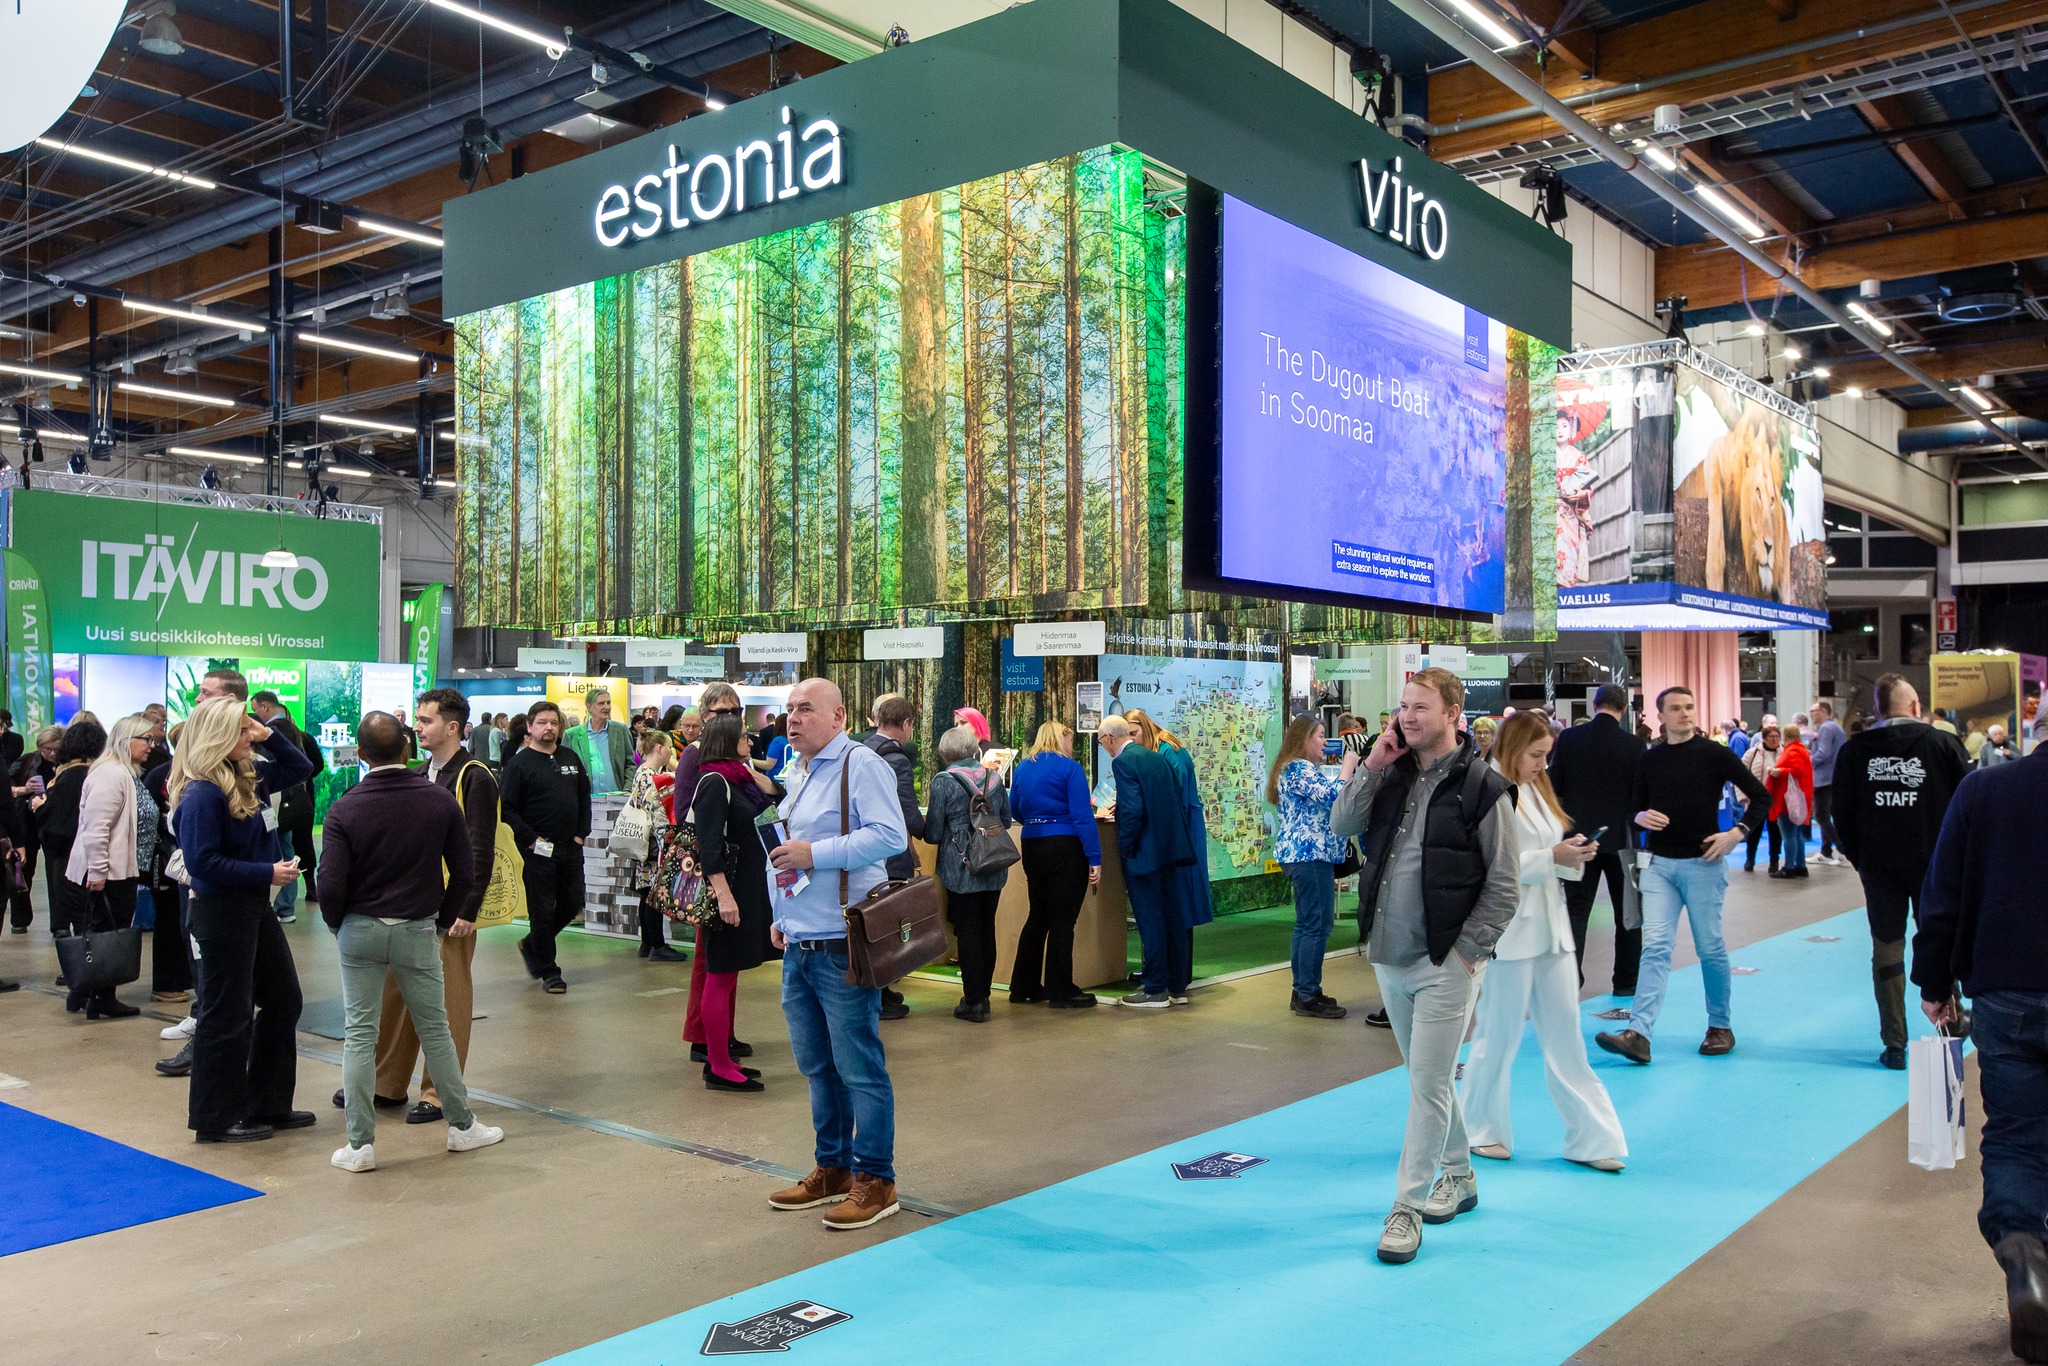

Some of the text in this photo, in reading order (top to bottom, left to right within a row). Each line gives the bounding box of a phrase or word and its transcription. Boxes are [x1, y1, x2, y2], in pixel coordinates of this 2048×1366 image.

[594, 106, 843, 248] estonia
[1361, 156, 1448, 260] viro
[1466, 333, 1479, 348] visit
[1466, 347, 1487, 365] estonia
[1260, 331, 1431, 419] The Dugout Boat
[1260, 382, 1374, 444] in Soomaa
[1333, 543, 1434, 570] The stunning natural world requires an
[81, 528, 329, 614] ITÄVIRO
[1336, 560, 1432, 584] extra season to explore the wonders.
[1559, 593, 1611, 605] VAELLUS
[85, 625, 325, 649] Uusi suosikkikohteesi Virossa!
[1040, 631, 1077, 640] Hiidenmaa
[1136, 634, 1167, 648] kartalle,
[1167, 637, 1188, 648] mihin
[1188, 637, 1218, 650] haluaisit
[1219, 639, 1254, 651] matkustaa
[747, 646, 799, 655] Viljandi ja Keski-Viro
[882, 640, 924, 651] Visit Haapsalu
[1035, 640, 1082, 651] ja Saarenmaa
[1006, 662, 1026, 674] visit
[1006, 674, 1040, 686] estonia
[1126, 682, 1152, 693] ESTONIA
[1875, 791, 1918, 807] STAFF
[752, 1320, 799, 1337] KNOW
[764, 1315, 811, 1332] SPAIN?
[727, 1328, 771, 1347] THINK
[744, 1326, 776, 1340] YOU
